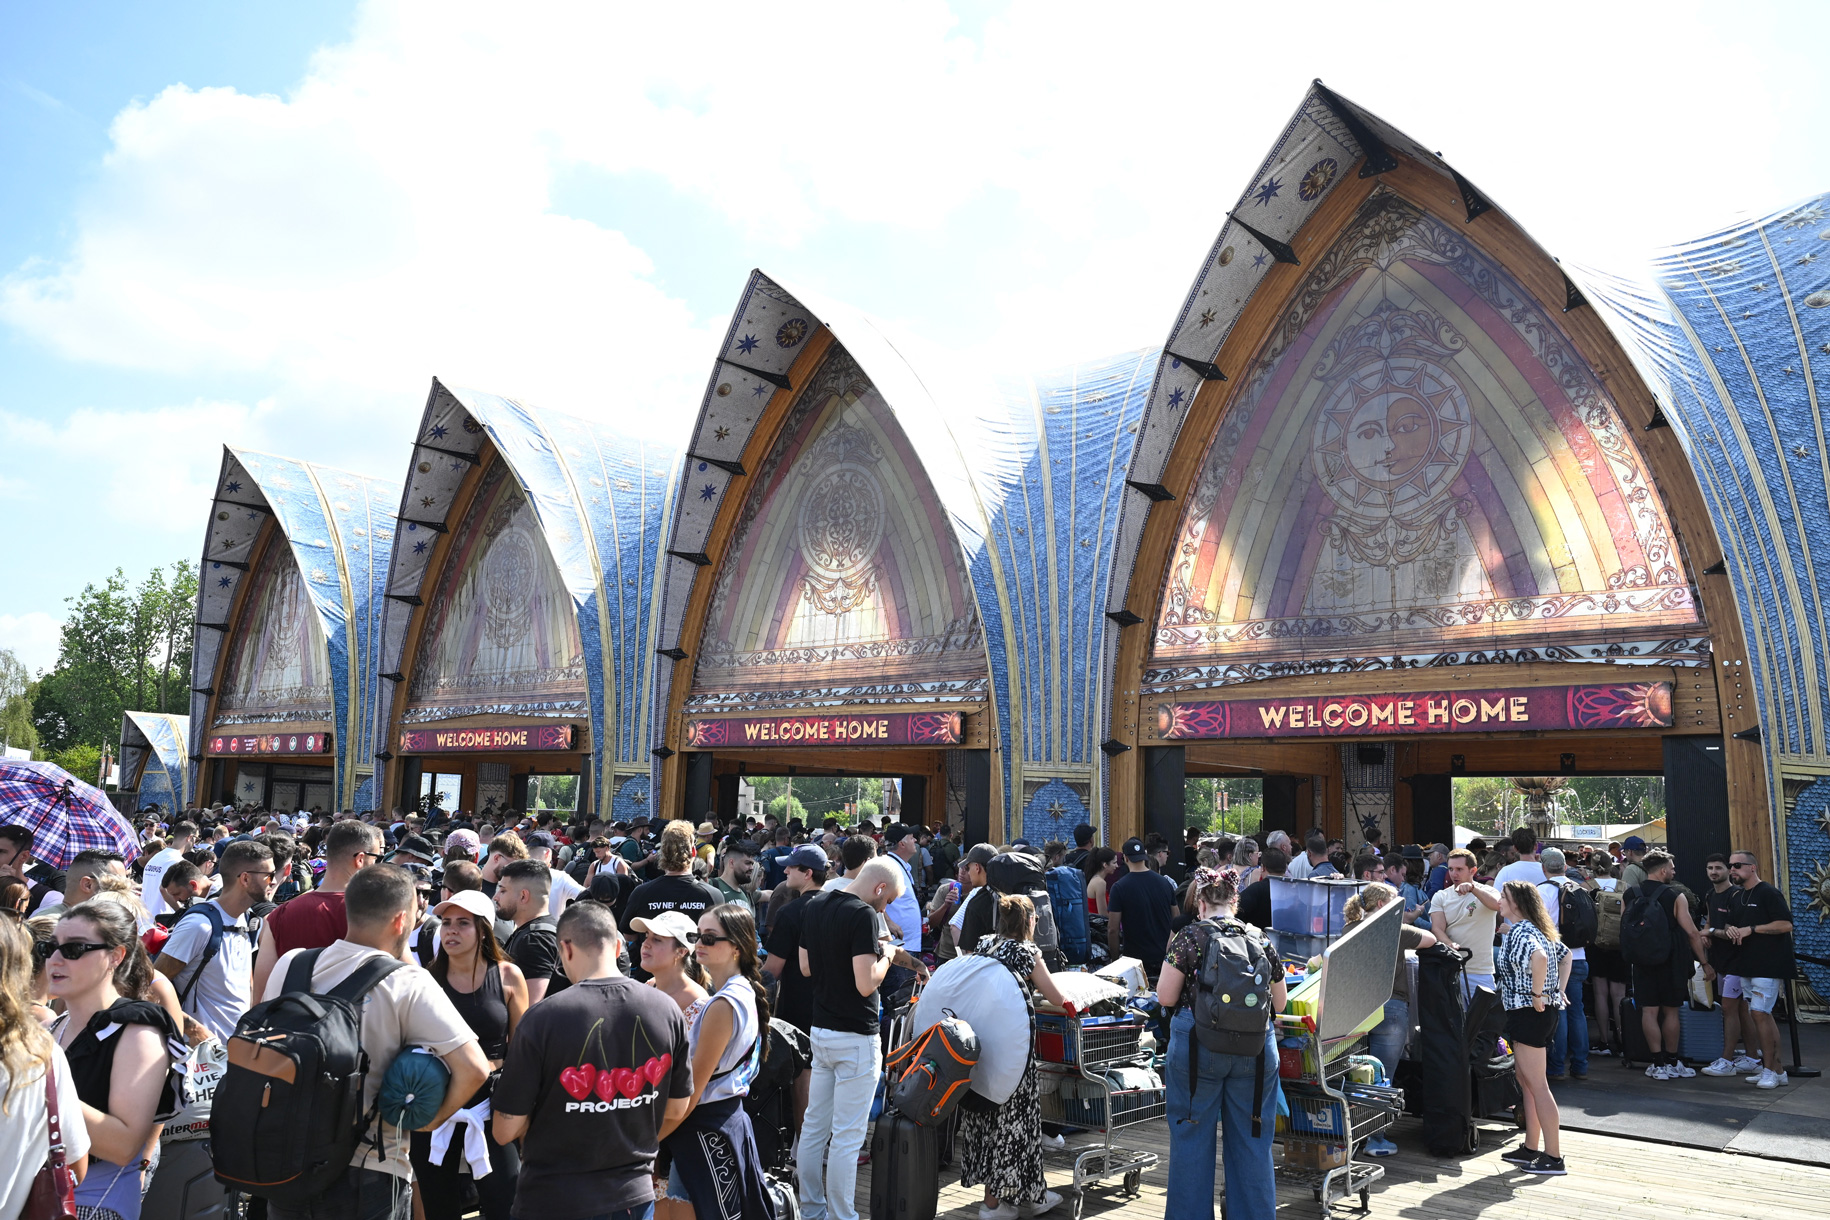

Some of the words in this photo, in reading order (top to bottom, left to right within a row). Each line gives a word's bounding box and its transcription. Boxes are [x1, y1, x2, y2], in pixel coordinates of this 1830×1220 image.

[1258, 701, 1414, 729] WELCOME
[1428, 697, 1529, 724] HOME
[744, 721, 829, 740] WELCOME
[835, 720, 889, 739] HOME
[436, 732, 490, 747] WELCOME
[493, 731, 528, 746] HOME
[648, 902, 661, 910] TSV
[662, 901, 706, 910] NEUAUSEN
[193, 1072, 221, 1086] VIE
[185, 1087, 215, 1104] CHE
